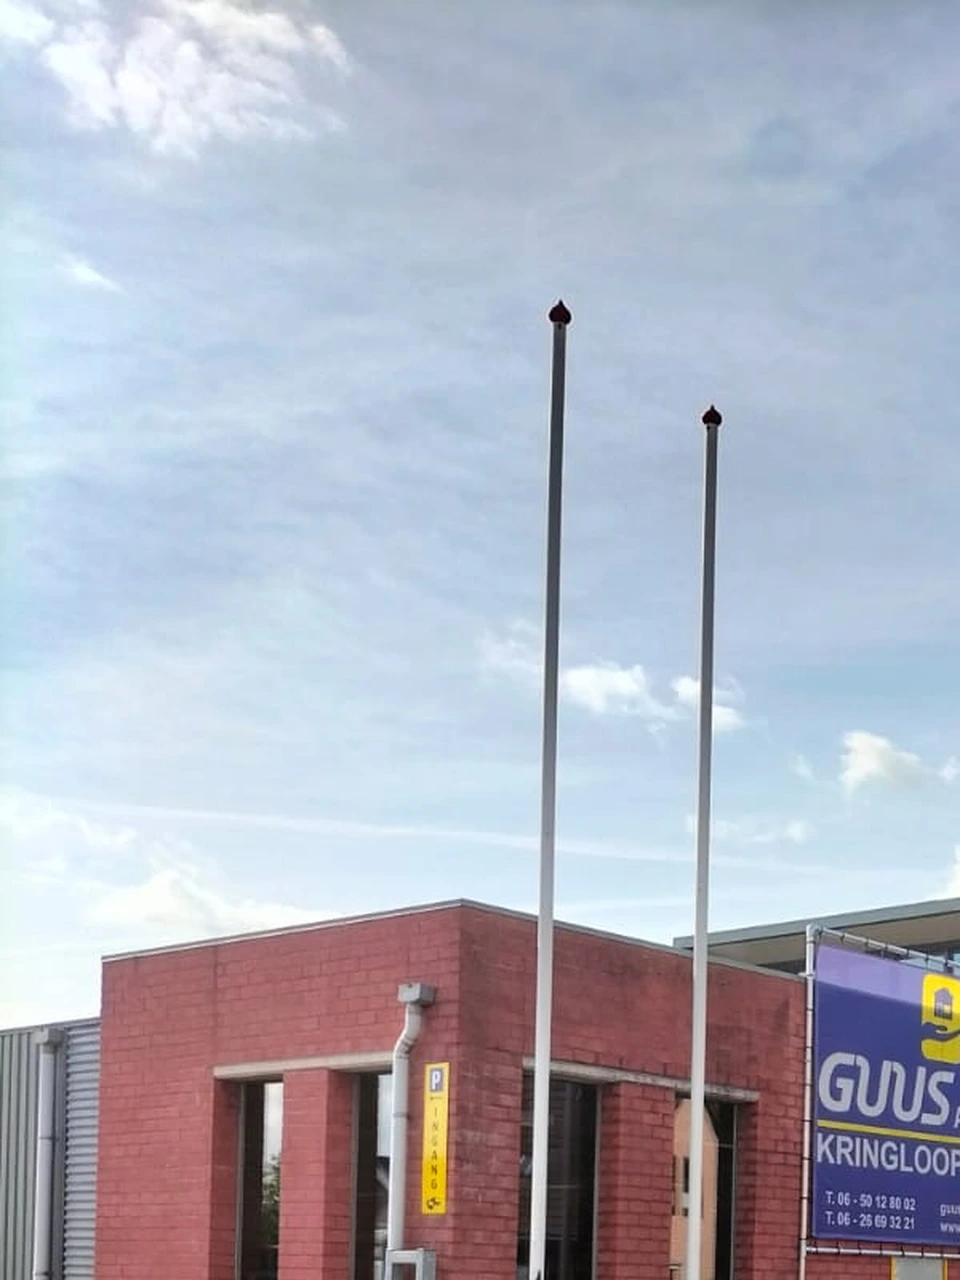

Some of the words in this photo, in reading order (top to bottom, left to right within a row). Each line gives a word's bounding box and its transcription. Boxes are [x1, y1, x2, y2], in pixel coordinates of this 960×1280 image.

[431, 1070, 441, 1090] P
[818, 1051, 956, 1126] GUUS
[429, 1107, 440, 1190] INGANG
[825, 1190, 835, 1205] T.
[837, 1191, 850, 1206] 06
[860, 1193, 872, 1208] 50
[875, 1194, 887, 1209] 12
[903, 1197, 916, 1211] 02
[825, 1210, 835, 1225] T.
[837, 1211, 850, 1226] 06
[889, 1215, 901, 1229] 32
[903, 1216, 915, 1230] 21
